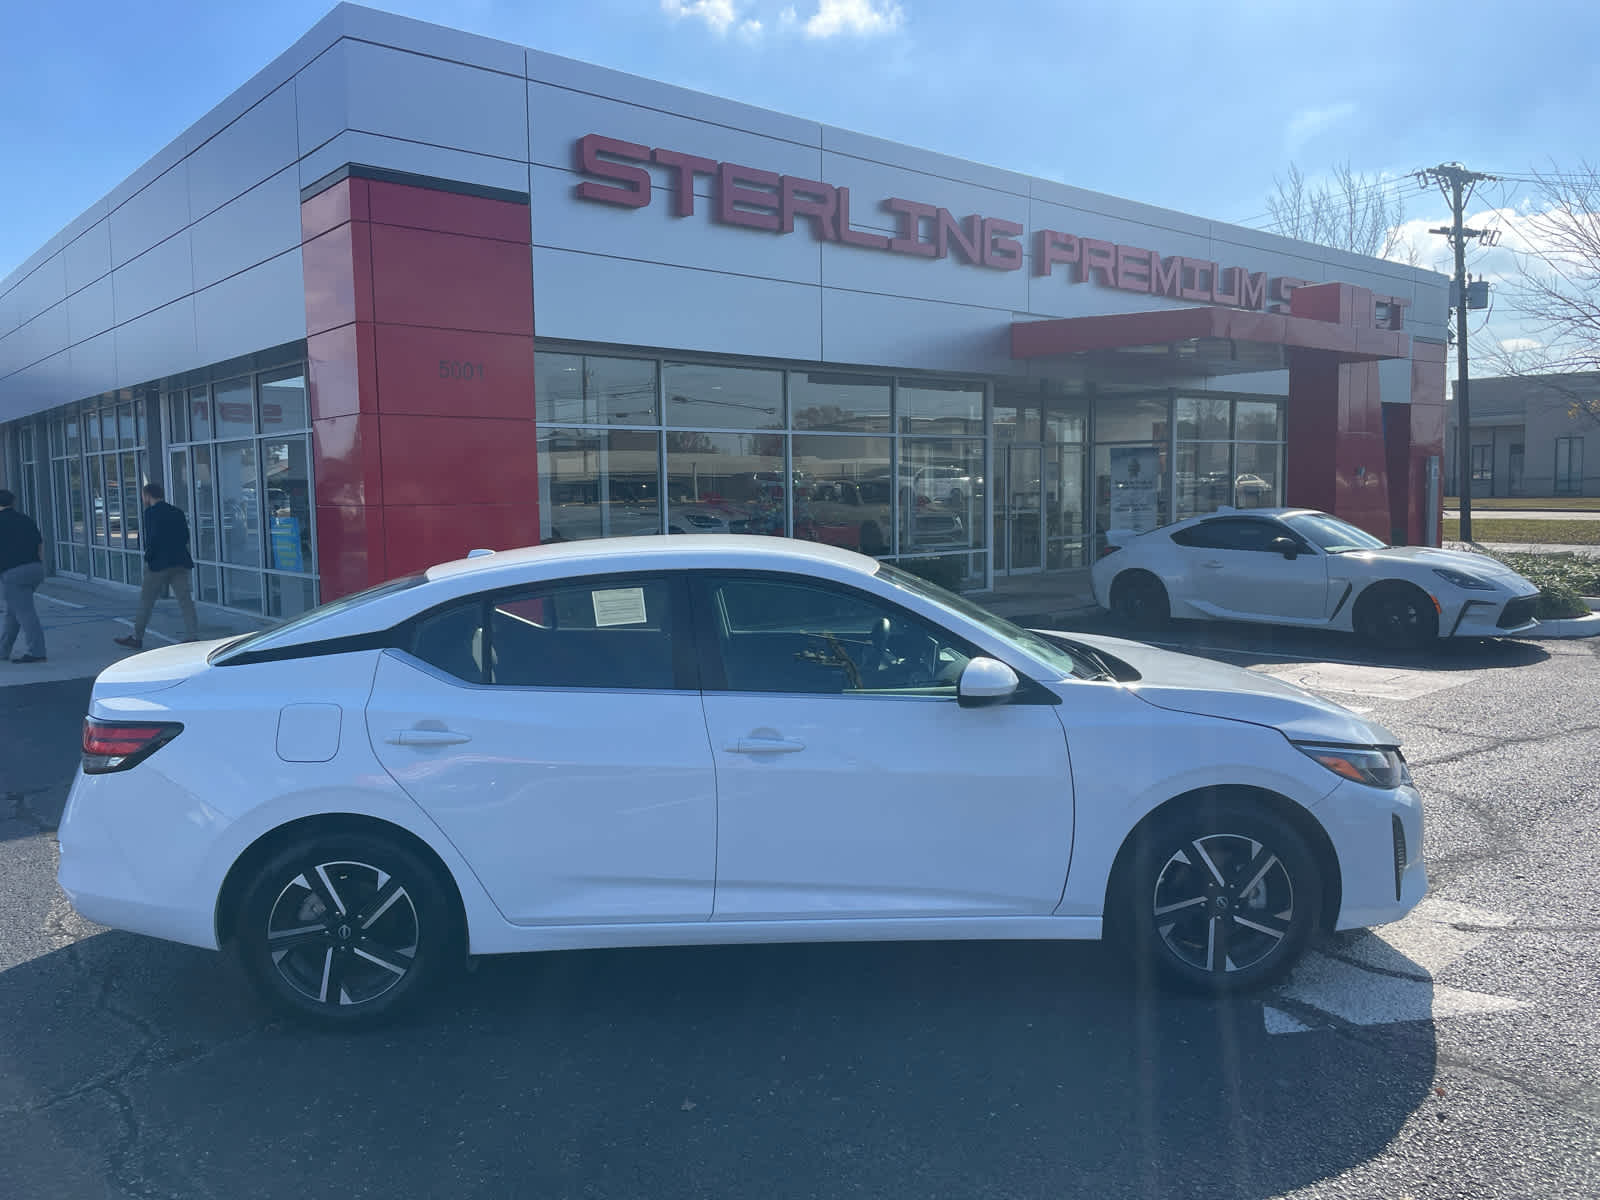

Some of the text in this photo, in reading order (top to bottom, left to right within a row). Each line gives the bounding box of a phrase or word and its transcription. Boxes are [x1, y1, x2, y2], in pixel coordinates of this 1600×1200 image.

[575, 133, 1023, 271] STERLING
[1036, 229, 1268, 312] PREMIUM
[439, 359, 484, 381] 5001
